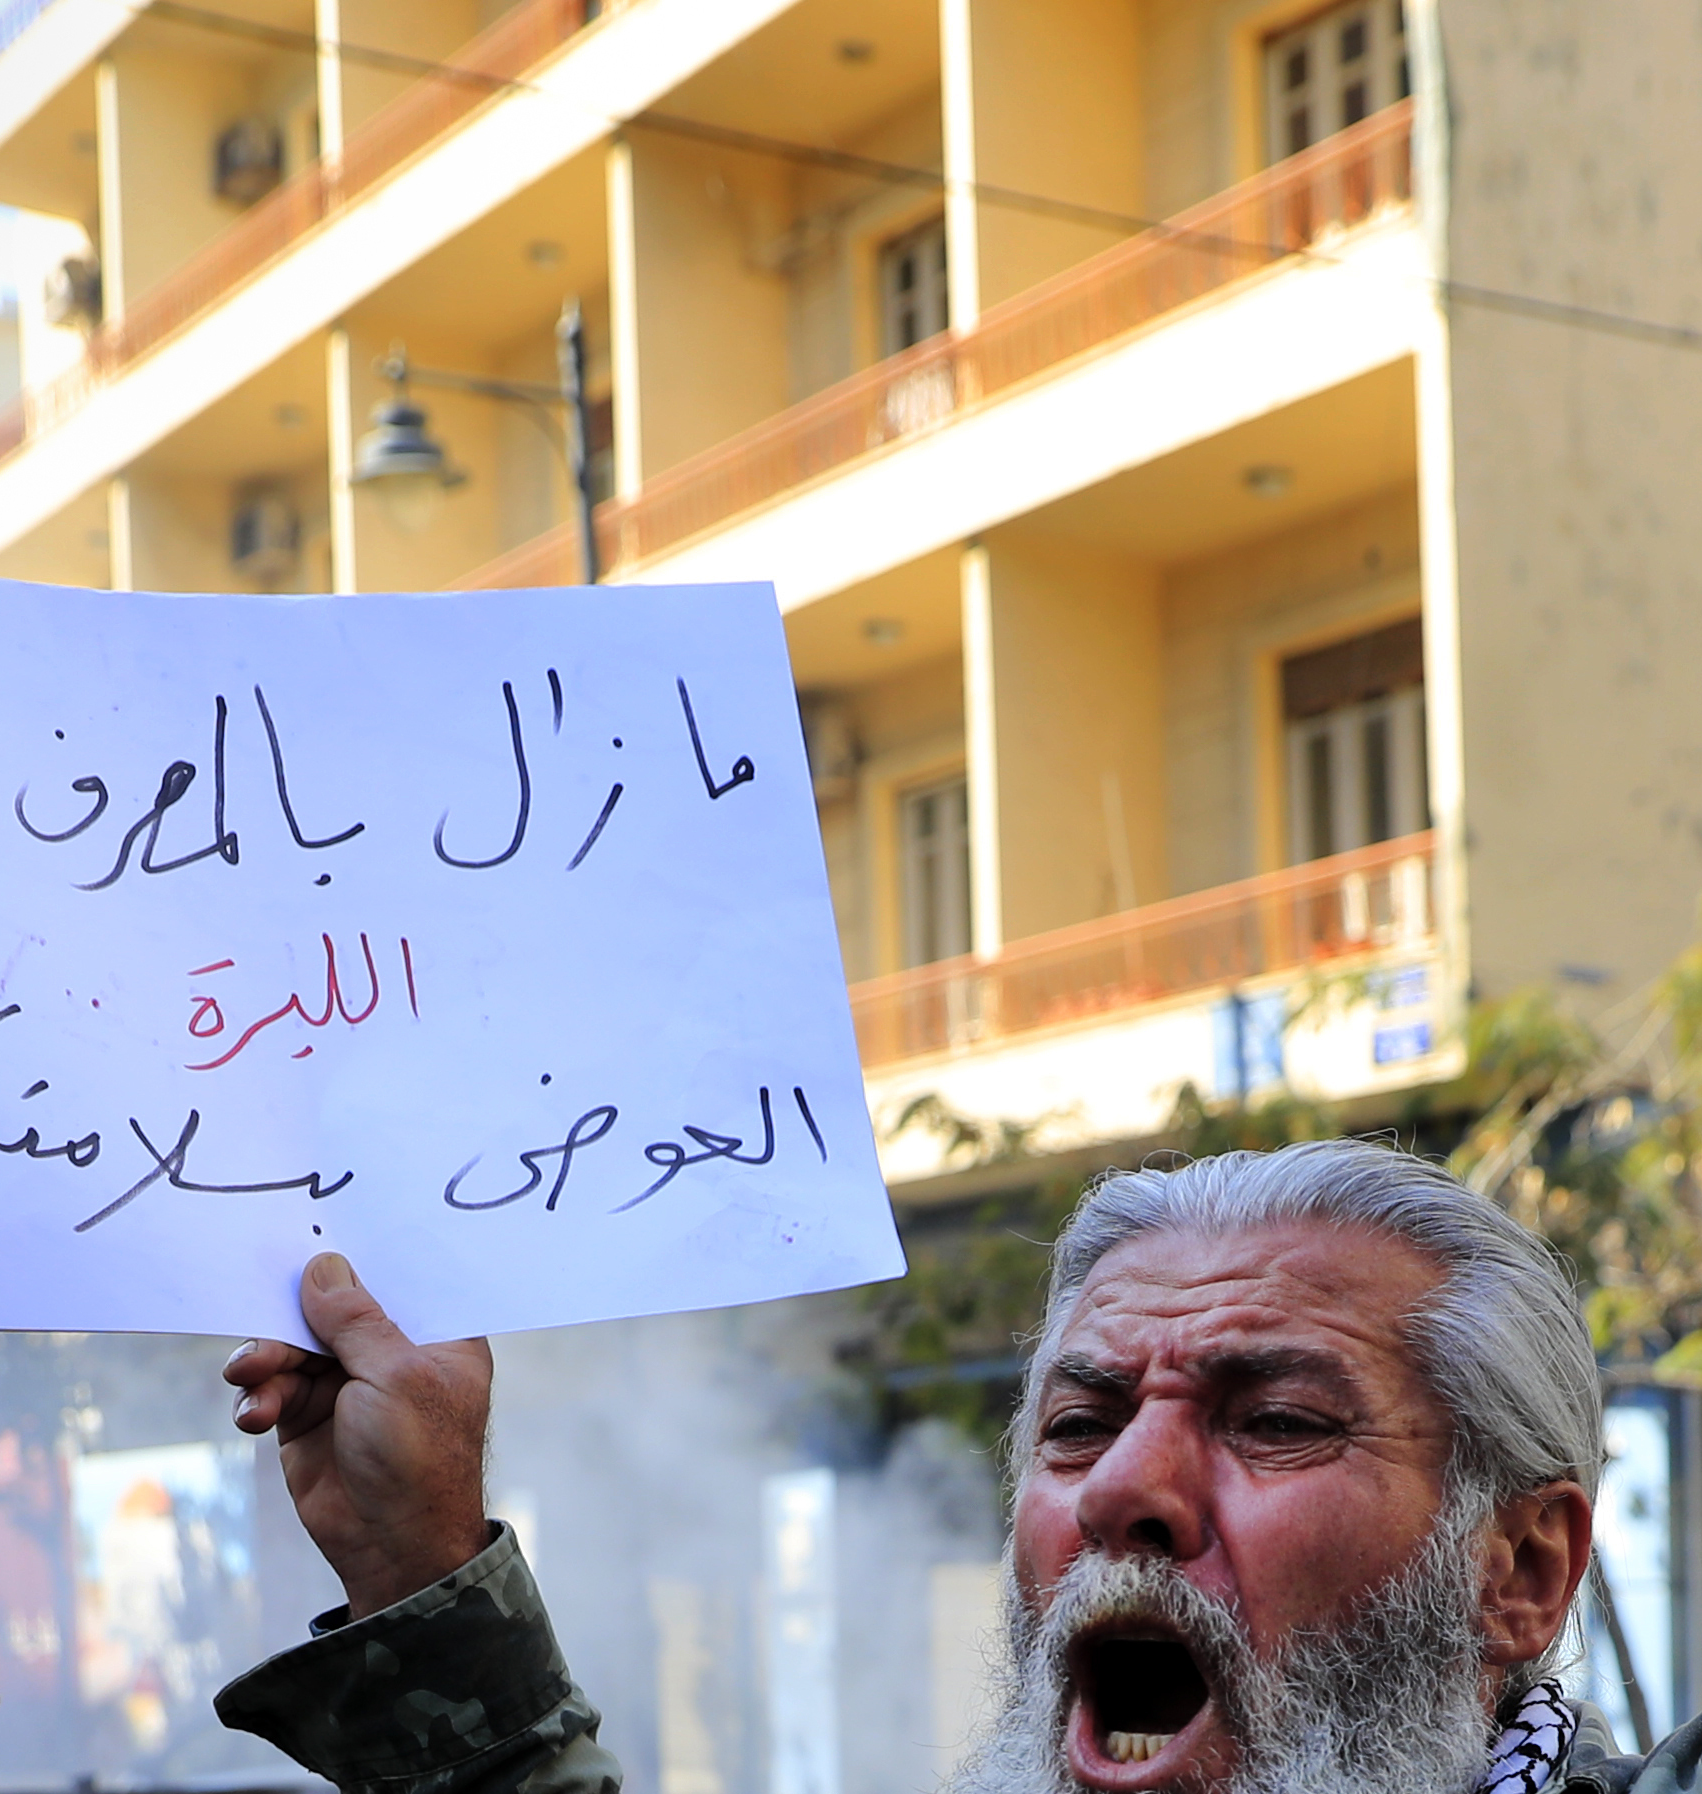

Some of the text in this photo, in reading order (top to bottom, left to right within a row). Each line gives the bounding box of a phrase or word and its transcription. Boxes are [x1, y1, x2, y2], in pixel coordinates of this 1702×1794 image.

[14, 681, 365, 892] بالمصرف
[676, 675, 756, 801] ما
[184, 931, 419, 1071] الليرة
[443, 1072, 828, 1213] العوض
